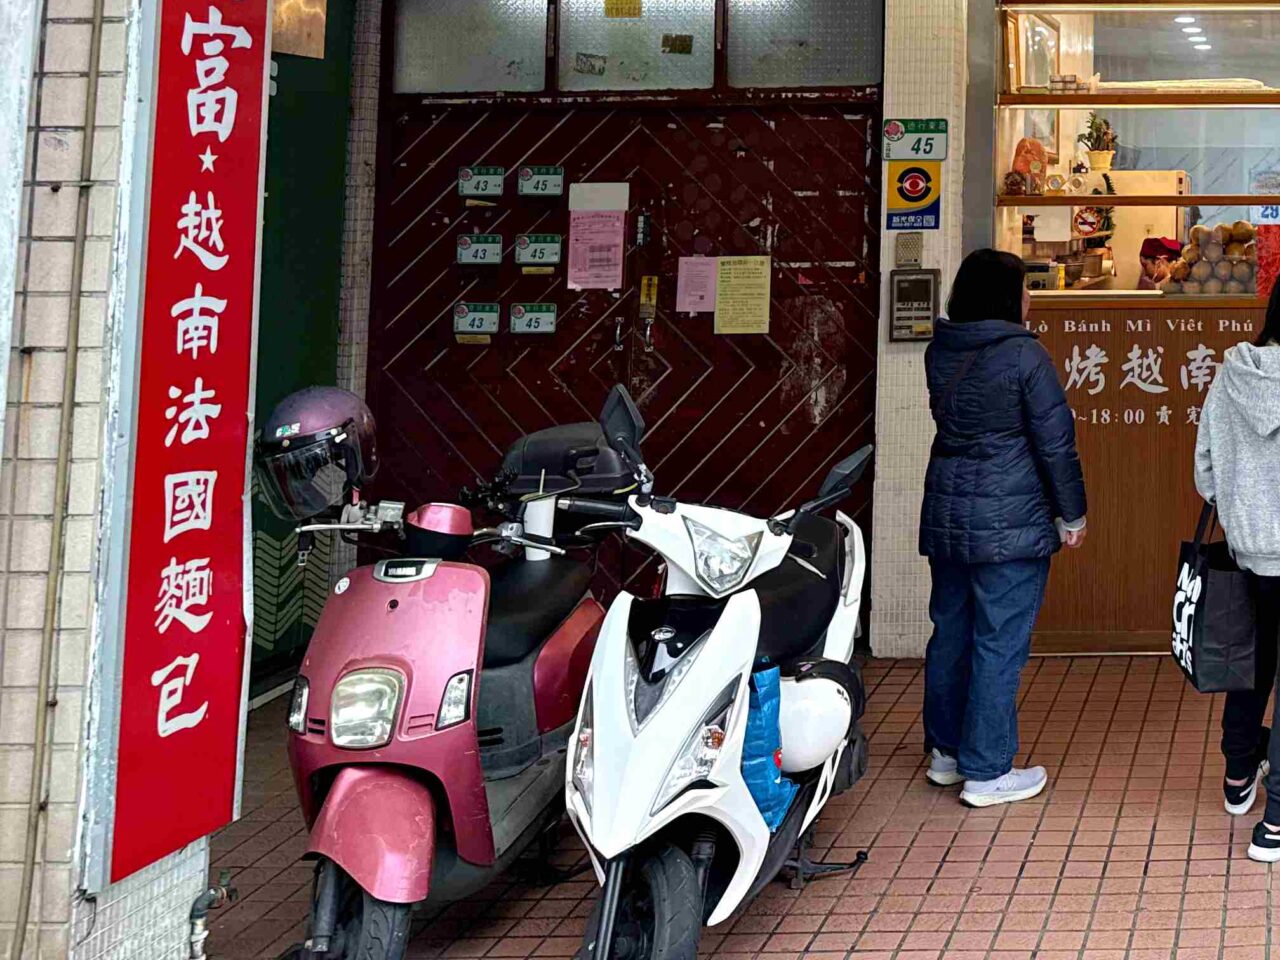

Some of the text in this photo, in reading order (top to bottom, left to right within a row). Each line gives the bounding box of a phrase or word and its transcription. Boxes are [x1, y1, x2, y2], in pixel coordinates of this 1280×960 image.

[911, 137, 935, 155] 45
[473, 179, 489, 192] 43
[533, 179, 549, 191] 45
[472, 248, 488, 260] 43
[530, 248, 546, 259] 45
[468, 317, 485, 329] 43
[525, 317, 541, 329] 45
[1025, 320, 1048, 333] Lò
[1064, 319, 1111, 333] Bánh
[1126, 319, 1151, 332] Mì
[1219, 319, 1253, 332] Phú
[1071, 408, 1145, 424] ~18:00
[150, 190, 229, 739] 越南法國麵包
